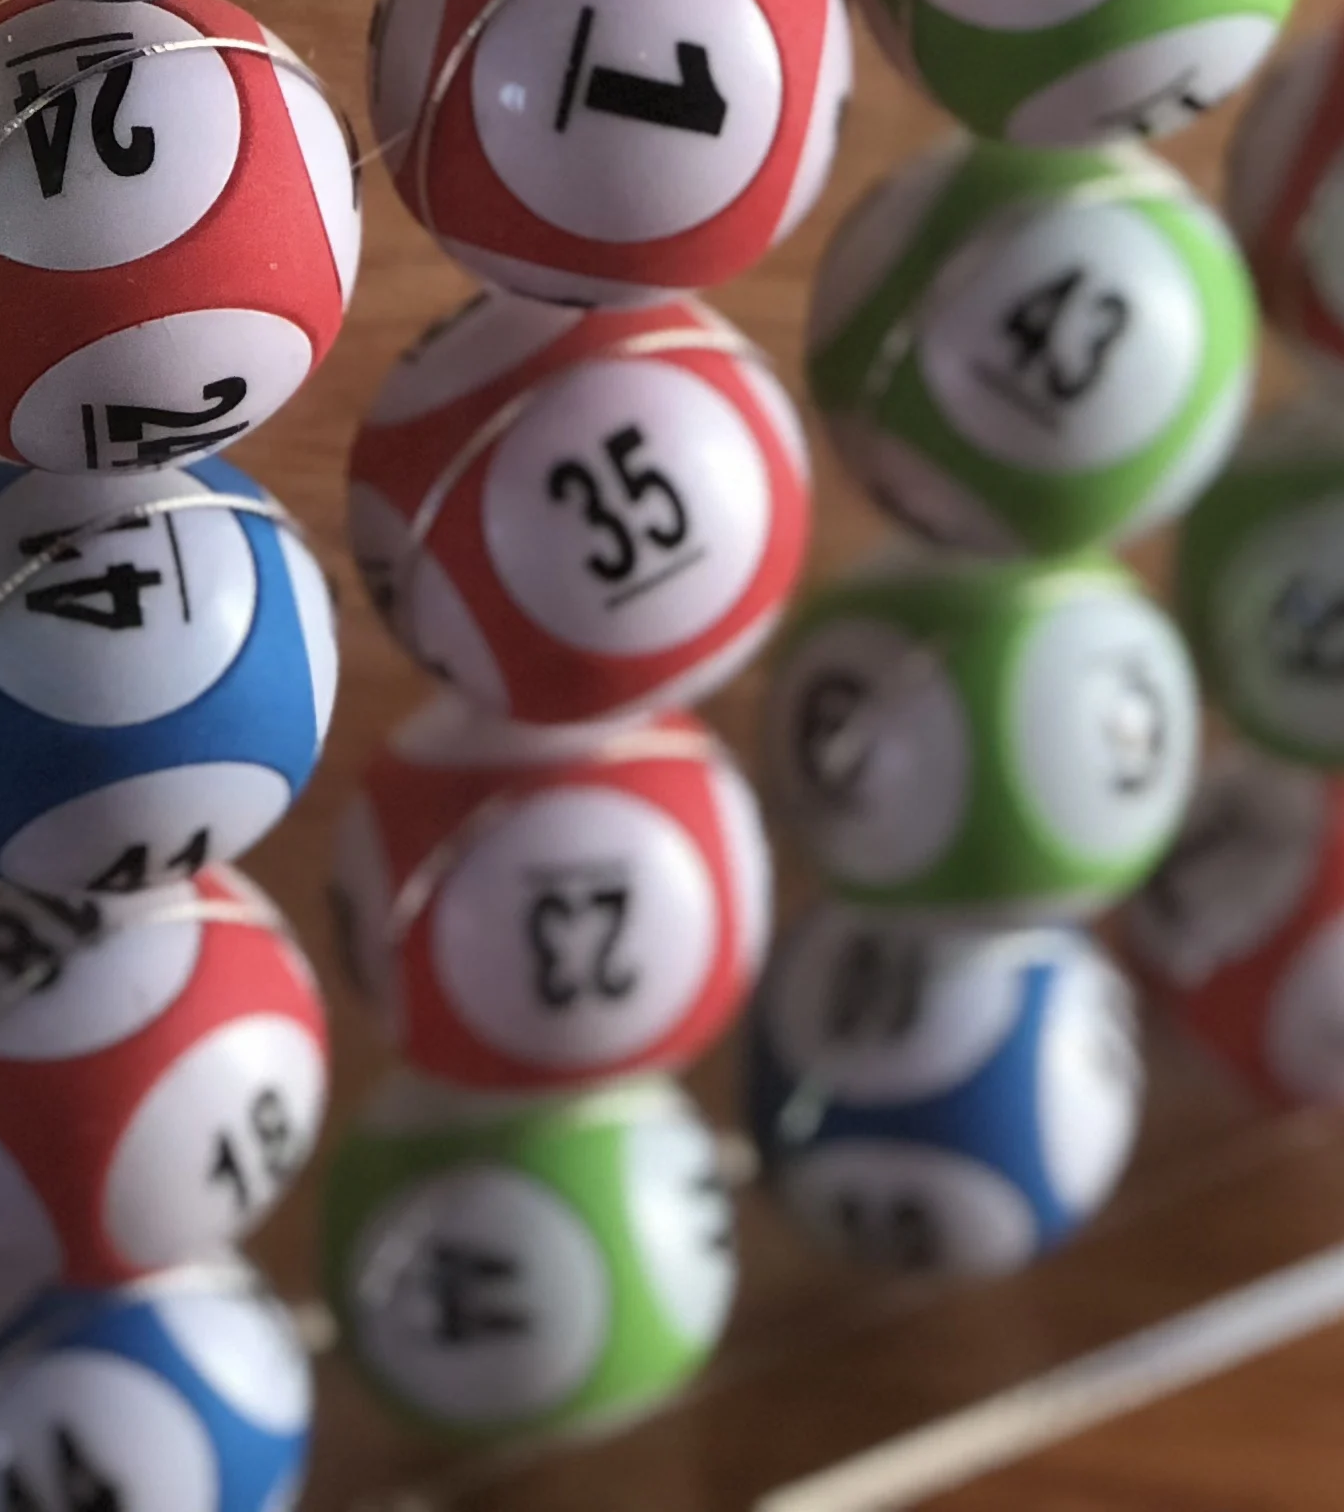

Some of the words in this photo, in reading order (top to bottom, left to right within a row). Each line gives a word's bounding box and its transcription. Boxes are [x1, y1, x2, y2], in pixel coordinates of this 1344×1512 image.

[13, 50, 156, 200] 24
[584, 40, 728, 138] 1
[548, 423, 690, 581] 35
[528, 886, 644, 1012] 23
